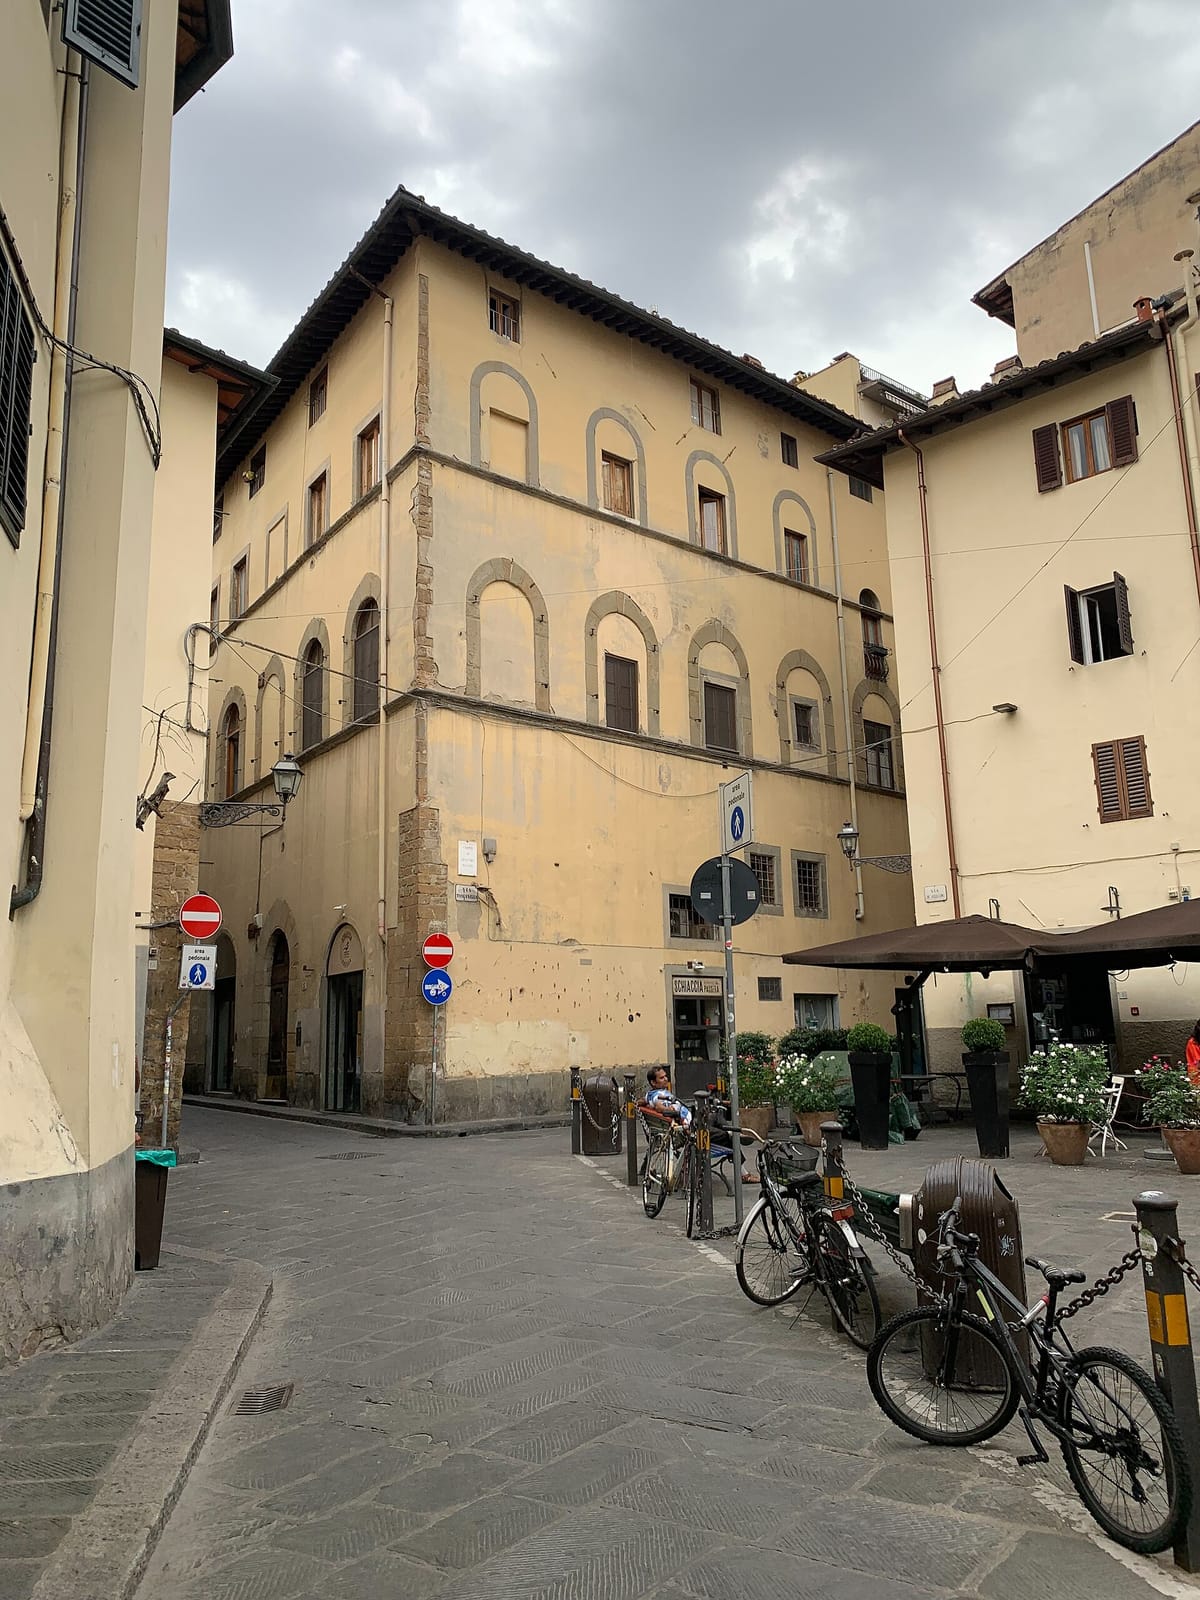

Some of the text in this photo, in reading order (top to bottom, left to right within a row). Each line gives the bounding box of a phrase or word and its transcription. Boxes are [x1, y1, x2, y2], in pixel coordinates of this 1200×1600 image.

[731, 783, 741, 793] area
[728, 791, 745, 808] pedonale
[673, 979, 703, 993] SCHIACCIA
